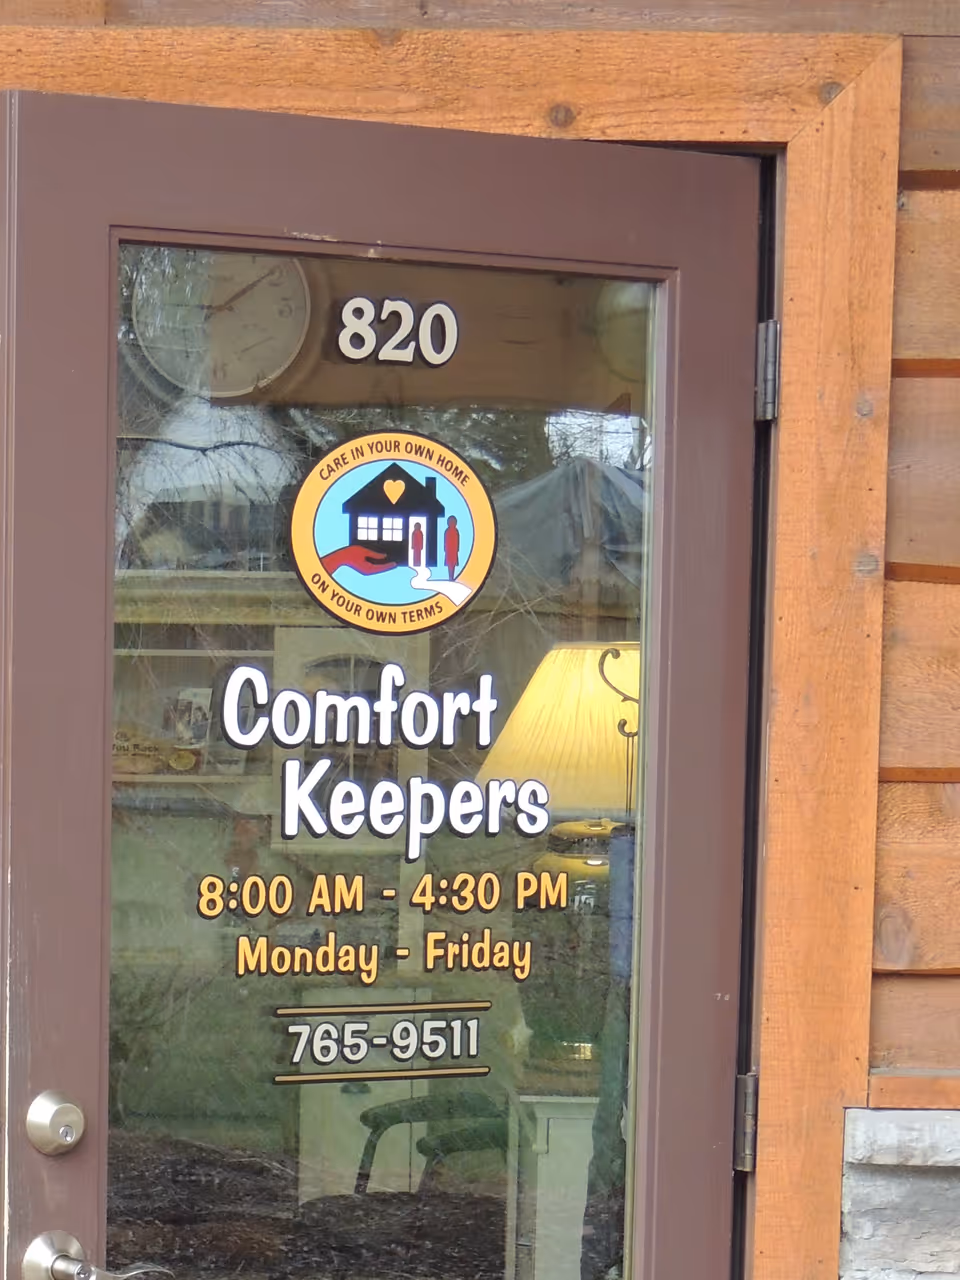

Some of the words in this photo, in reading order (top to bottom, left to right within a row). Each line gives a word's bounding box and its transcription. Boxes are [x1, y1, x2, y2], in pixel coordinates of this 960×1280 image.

[337, 296, 459, 366] 820
[319, 453, 350, 481] CARE
[352, 446, 364, 460] IN
[367, 440, 400, 454] YOUR
[405, 442, 434, 461] OWN
[436, 455, 470, 487] HOME
[311, 573, 329, 593] ON
[330, 589, 361, 617] YOUR
[366, 608, 396, 624] OWN
[401, 601, 443, 624] TERMS
[222, 663, 499, 748] Comfort
[282, 758, 551, 862] Keepers
[197, 873, 294, 917] 8:00
[308, 873, 365, 914] AM
[382, 887, 397, 899] -
[410, 871, 501, 913] 4:30
[517, 871, 569, 911] PM
[237, 932, 380, 984] Monday
[396, 946, 411, 959] -
[425, 928, 533, 981] Friday
[287, 1018, 480, 1065] 765-9511
